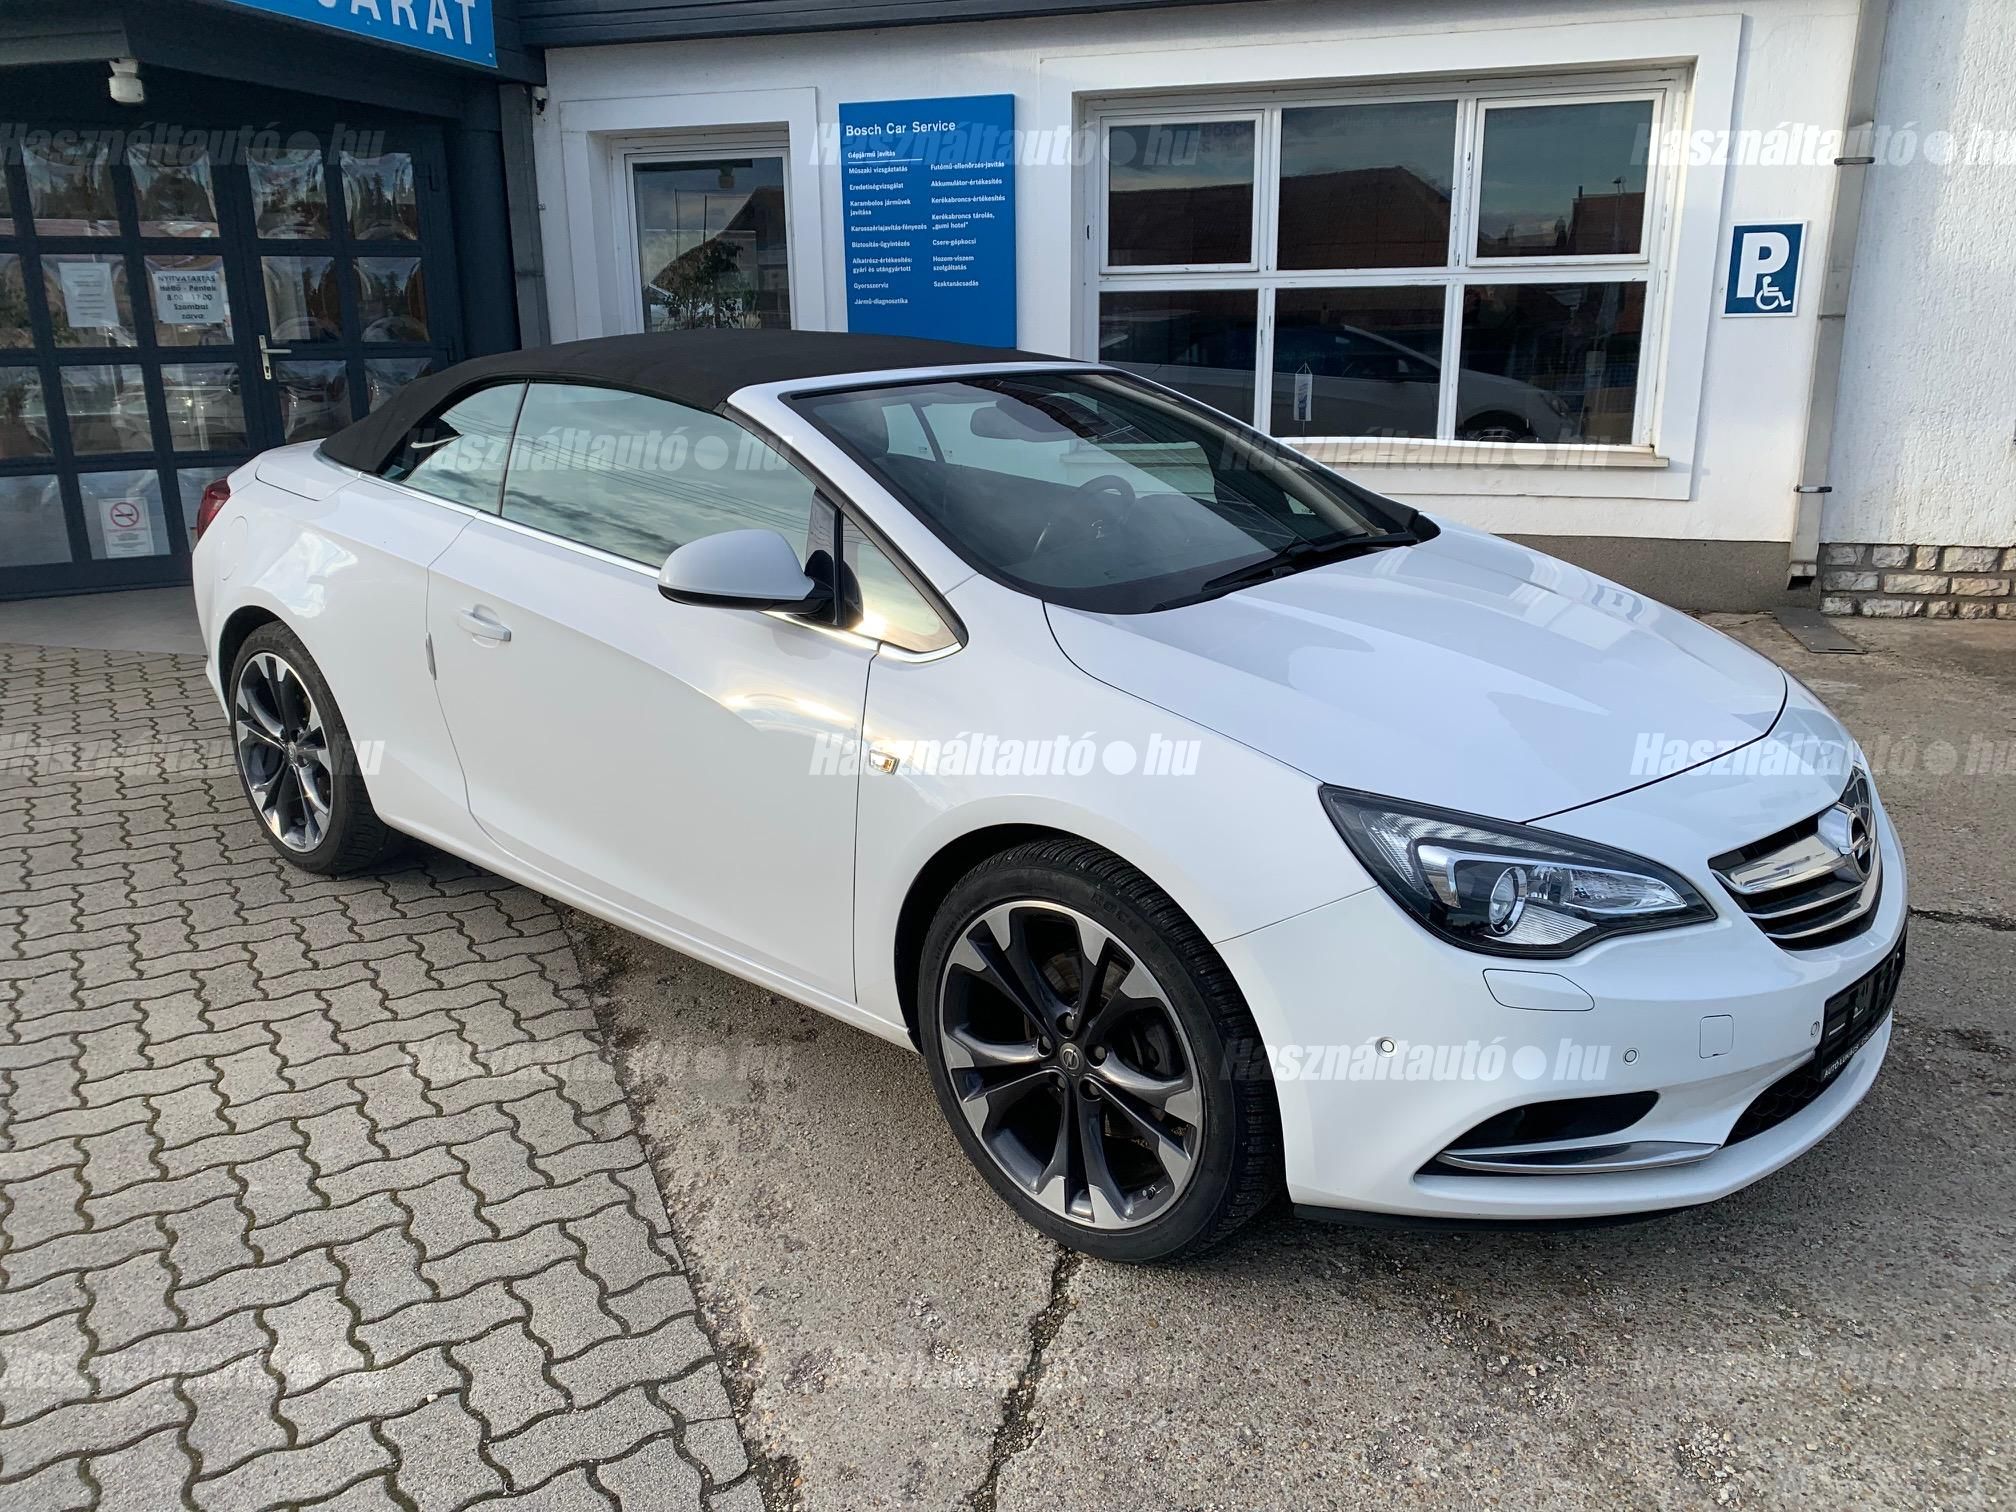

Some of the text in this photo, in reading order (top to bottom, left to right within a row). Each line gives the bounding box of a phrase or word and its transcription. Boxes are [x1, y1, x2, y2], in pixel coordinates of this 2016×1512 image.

[846, 120, 956, 136] Bosch Car Service
[1736, 232, 1790, 298] P
[853, 282, 889, 290] Gyorsszerviz
